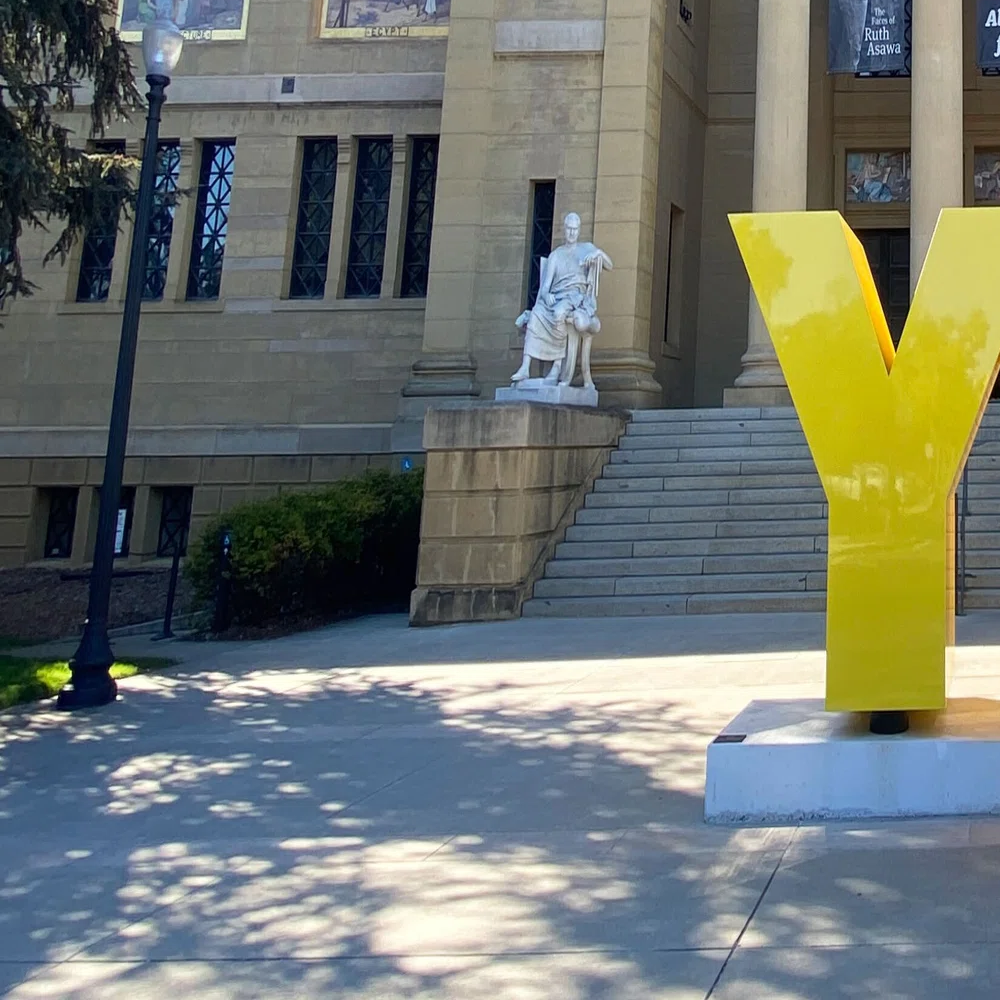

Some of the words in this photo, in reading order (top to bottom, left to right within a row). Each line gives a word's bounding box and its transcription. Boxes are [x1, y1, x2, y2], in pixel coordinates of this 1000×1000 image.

[874, 7, 886, 17] The
[871, 16, 888, 26] Faces
[888, 15, 896, 25] of
[864, 26, 890, 41] Ruth
[867, 42, 901, 56] Asawa
